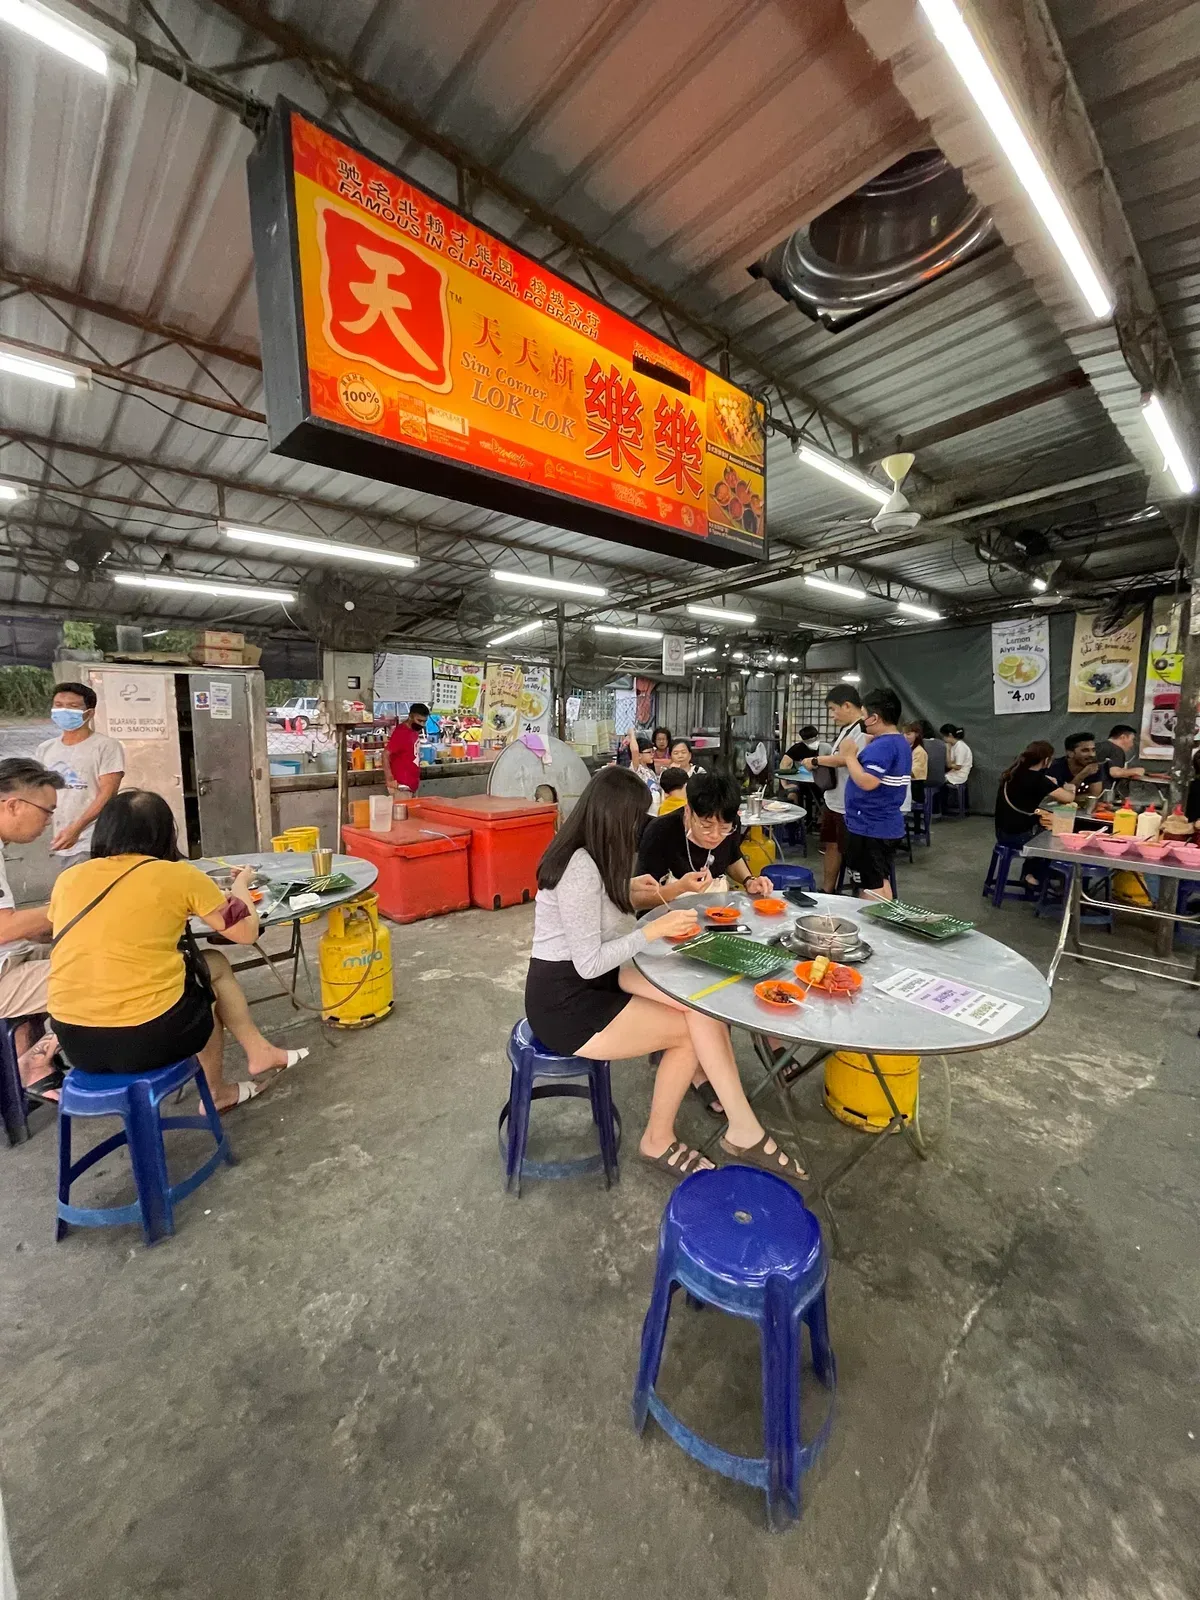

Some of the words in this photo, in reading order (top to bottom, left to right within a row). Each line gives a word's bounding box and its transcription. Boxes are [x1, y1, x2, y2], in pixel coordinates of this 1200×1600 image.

[338, 180, 421, 238] FAMOUS
[425, 232, 443, 250] IN
[447, 246, 479, 268] CLP
[481, 266, 519, 297] PRAI,
[523, 290, 543, 308] PG
[546, 303, 599, 339] BRANCH
[339, 244, 438, 371] 天
[460, 350, 491, 378] Sim
[495, 366, 548, 400] Corner
[472, 311, 576, 391] 天天新
[342, 390, 380, 404] 100%
[471, 377, 524, 419] LOK
[530, 403, 576, 440] LOK
[584, 357, 705, 500] 樂樂
[1006, 636, 1031, 645] Lemon
[127, 726, 166, 734] SMOKING
